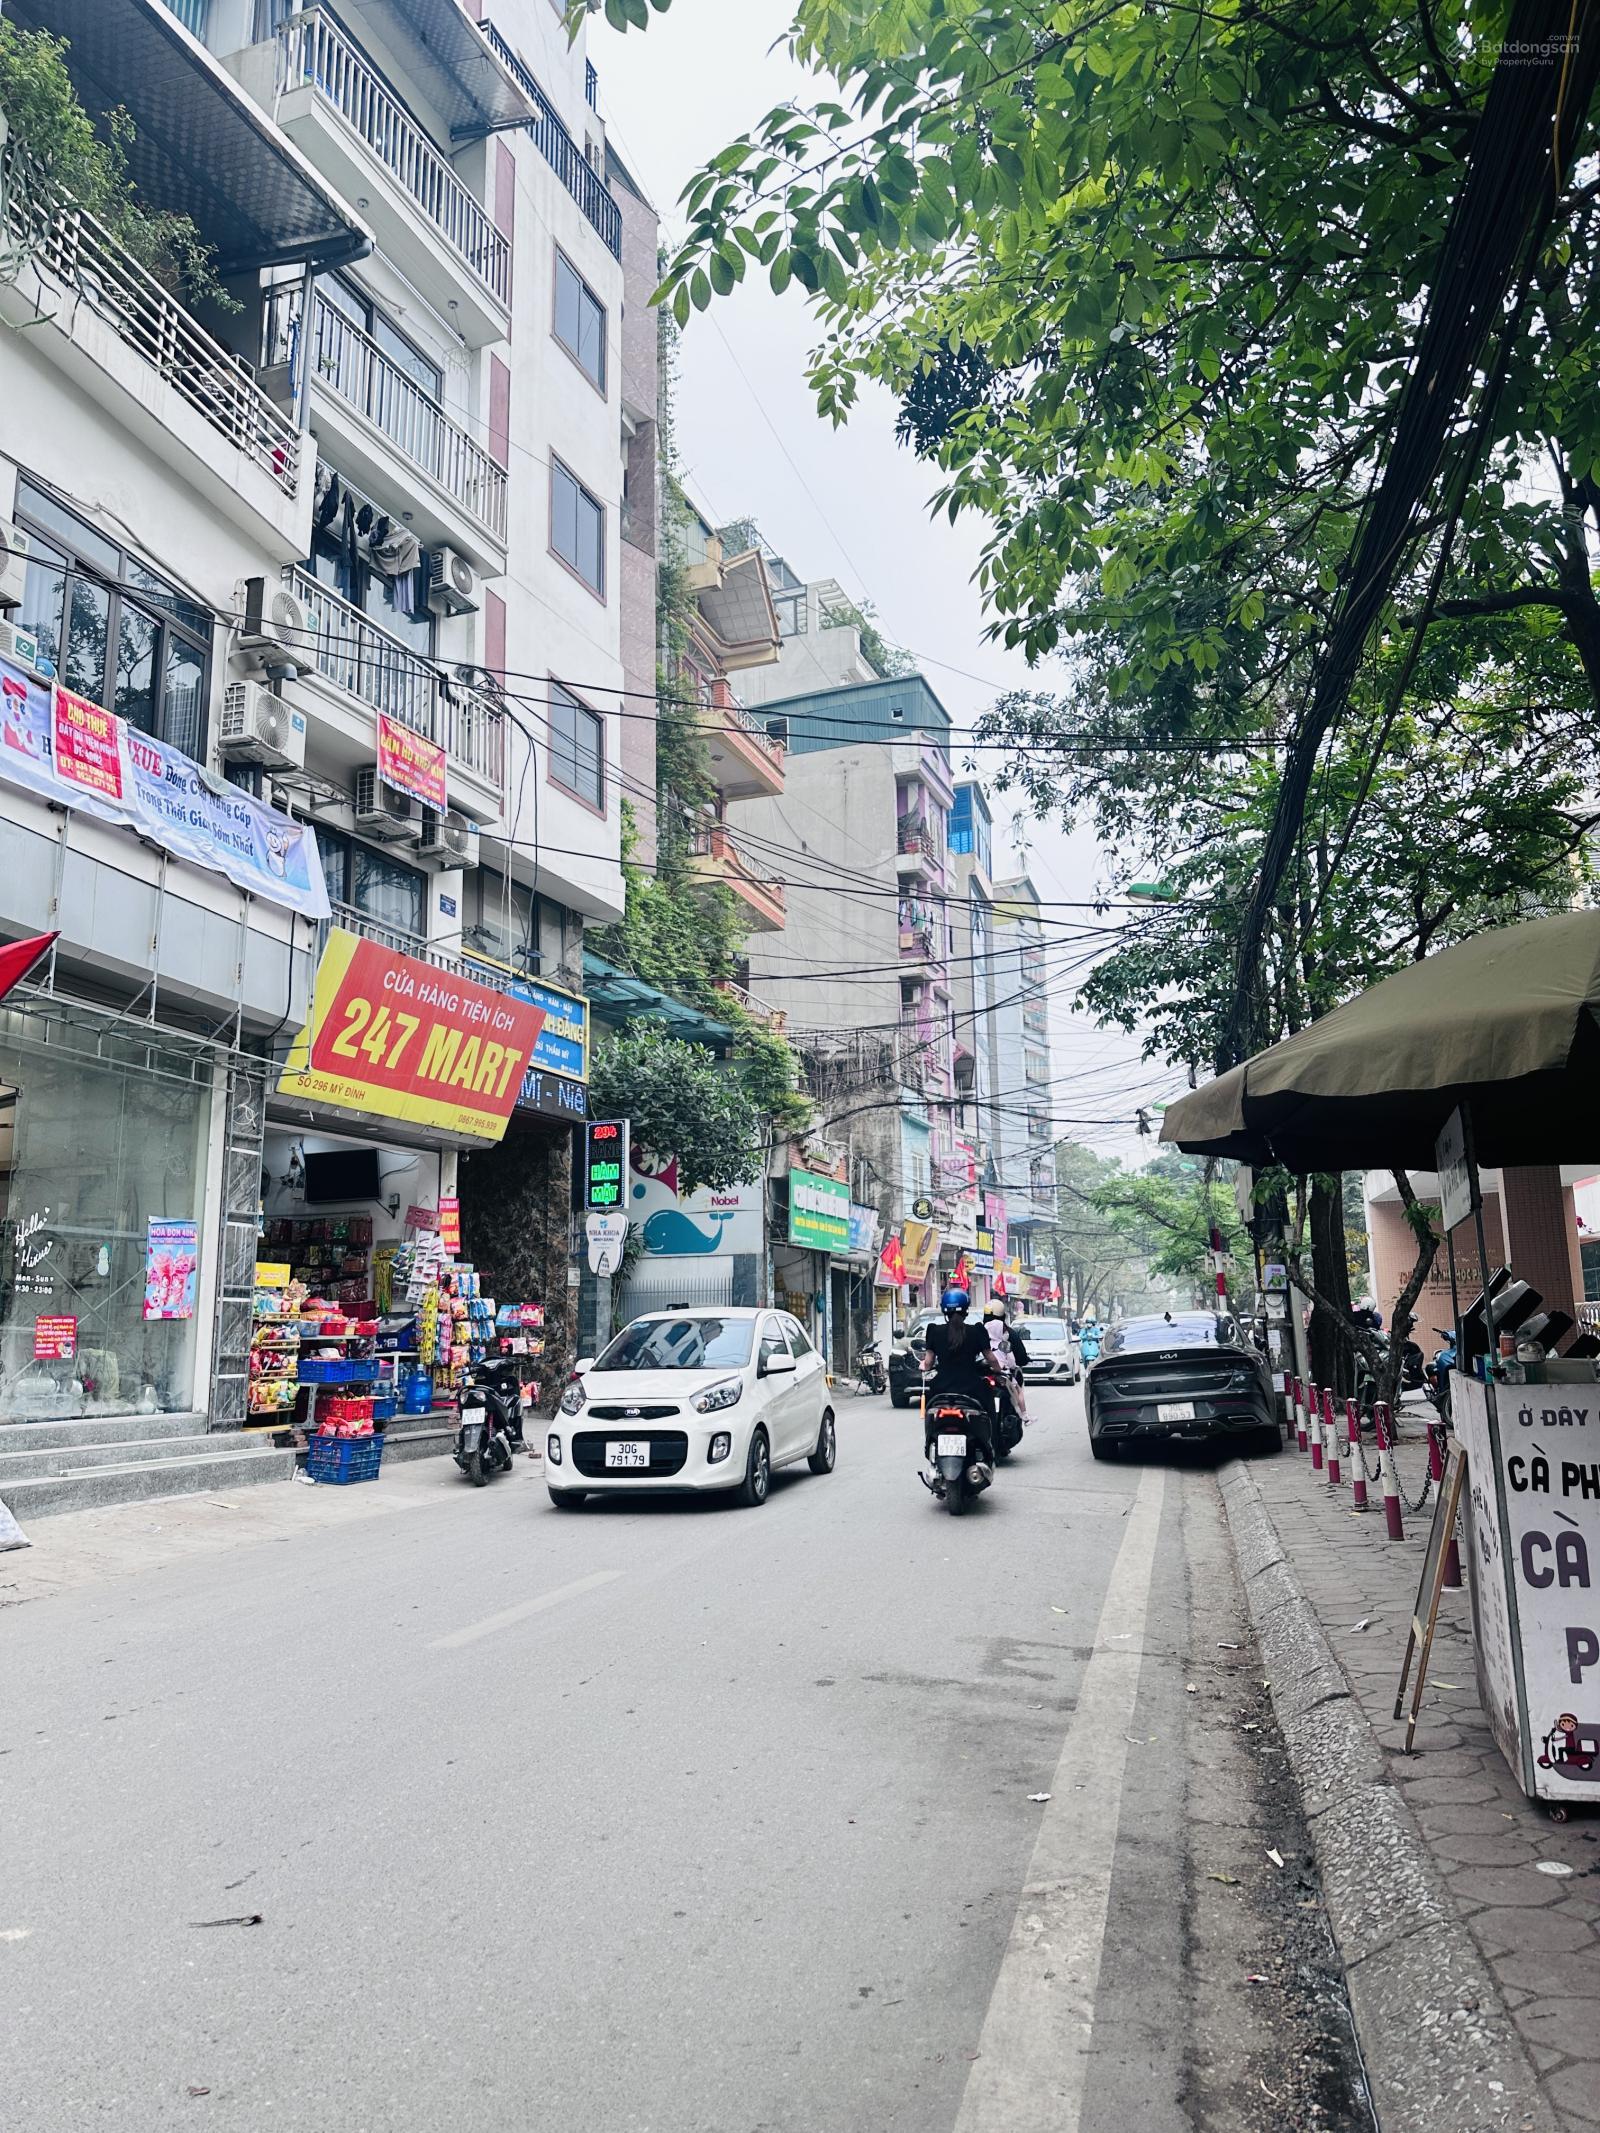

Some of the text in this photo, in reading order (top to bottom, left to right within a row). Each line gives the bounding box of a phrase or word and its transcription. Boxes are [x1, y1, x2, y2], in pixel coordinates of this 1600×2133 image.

[135, 781, 162, 814] Trong
[384, 968, 515, 1032] CỬA HÀNG TIỆN ÍCH
[332, 997, 523, 1098] 247 MART
[312, 1079, 329, 1092] 296
[329, 1082, 344, 1095] MỸ
[344, 1085, 366, 1101] ĐÌNH
[593, 1125, 617, 1139] 294
[591, 1161, 620, 1181] HÀM
[591, 1182, 618, 1205] MẶT
[711, 1196, 739, 1206] Nobel
[15, 1212, 45, 1247] Hello
[1518, 1403, 1534, 1427] Ở
[1540, 1406, 1588, 1427] ĐÂY
[611, 1455, 645, 1465] 791.79
[618, 1443, 637, 1454] 30G
[1508, 1443, 1600, 1499] CÀ PH
[1520, 1510, 1591, 1588] CÀ
